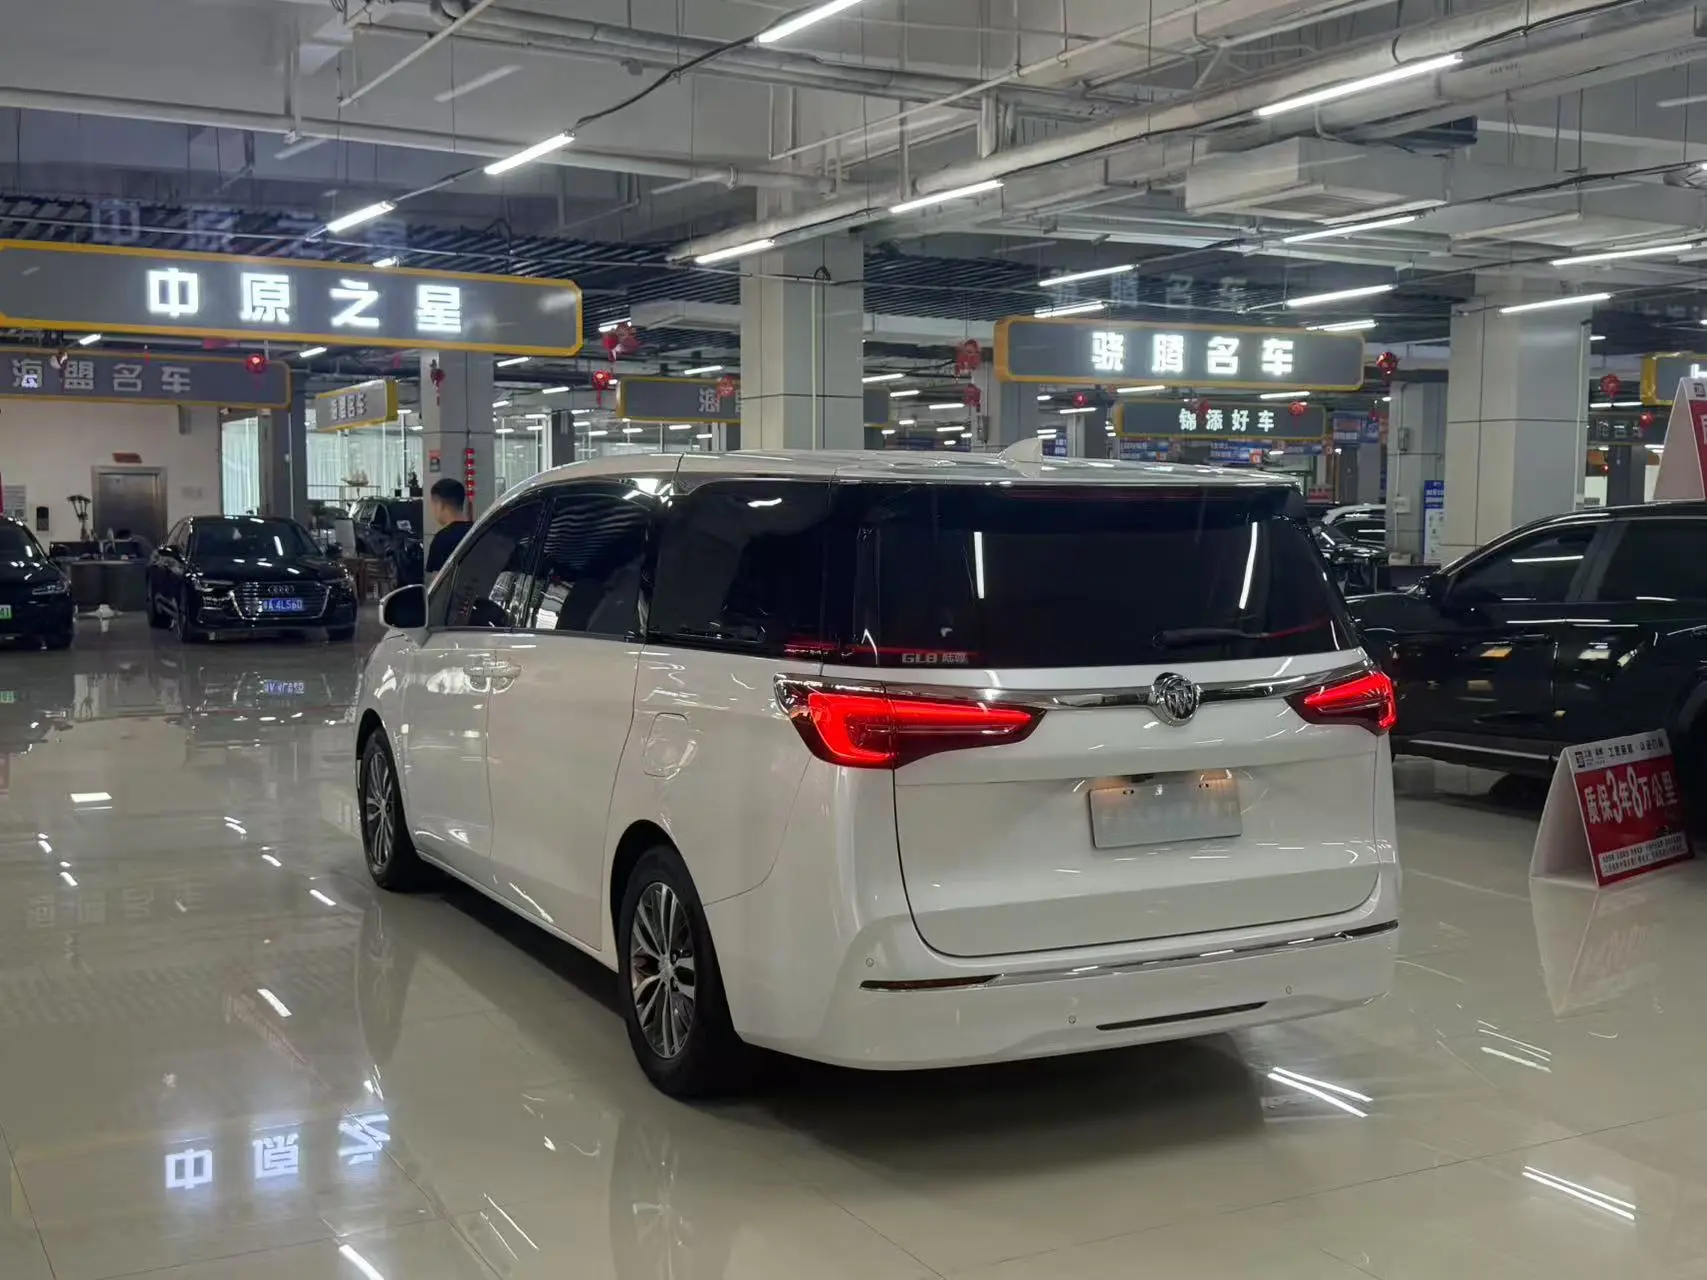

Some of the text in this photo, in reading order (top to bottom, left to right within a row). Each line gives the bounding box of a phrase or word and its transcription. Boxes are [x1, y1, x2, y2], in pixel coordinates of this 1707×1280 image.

[147, 267, 461, 333] 中原之星
[1092, 331, 1294, 376] 骁腾名车
[902, 653, 937, 663] GL8
